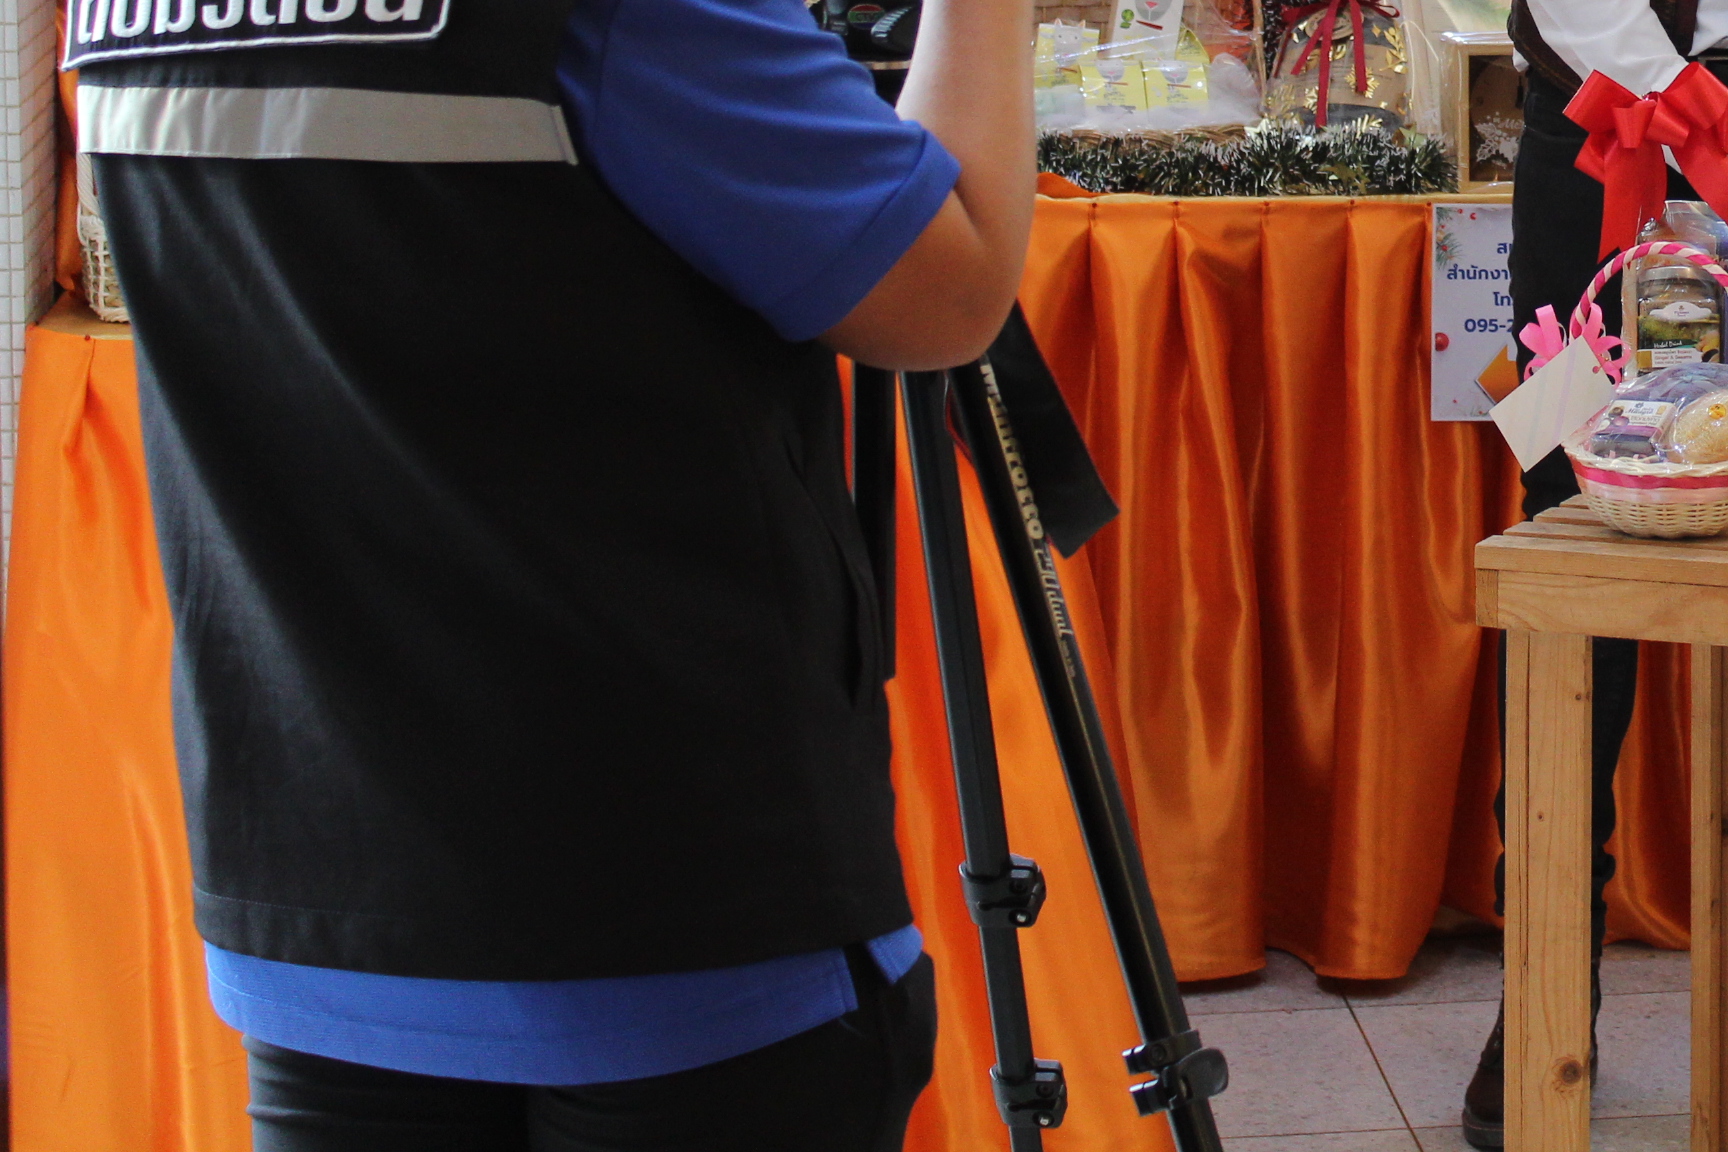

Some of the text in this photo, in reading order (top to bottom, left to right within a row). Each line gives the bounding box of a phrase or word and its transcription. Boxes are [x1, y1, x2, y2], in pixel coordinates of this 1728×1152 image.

[1447, 263, 1512, 281] สำนักงา
[1493, 291, 1513, 307] โท
[1464, 318, 1515, 334] 095-2
